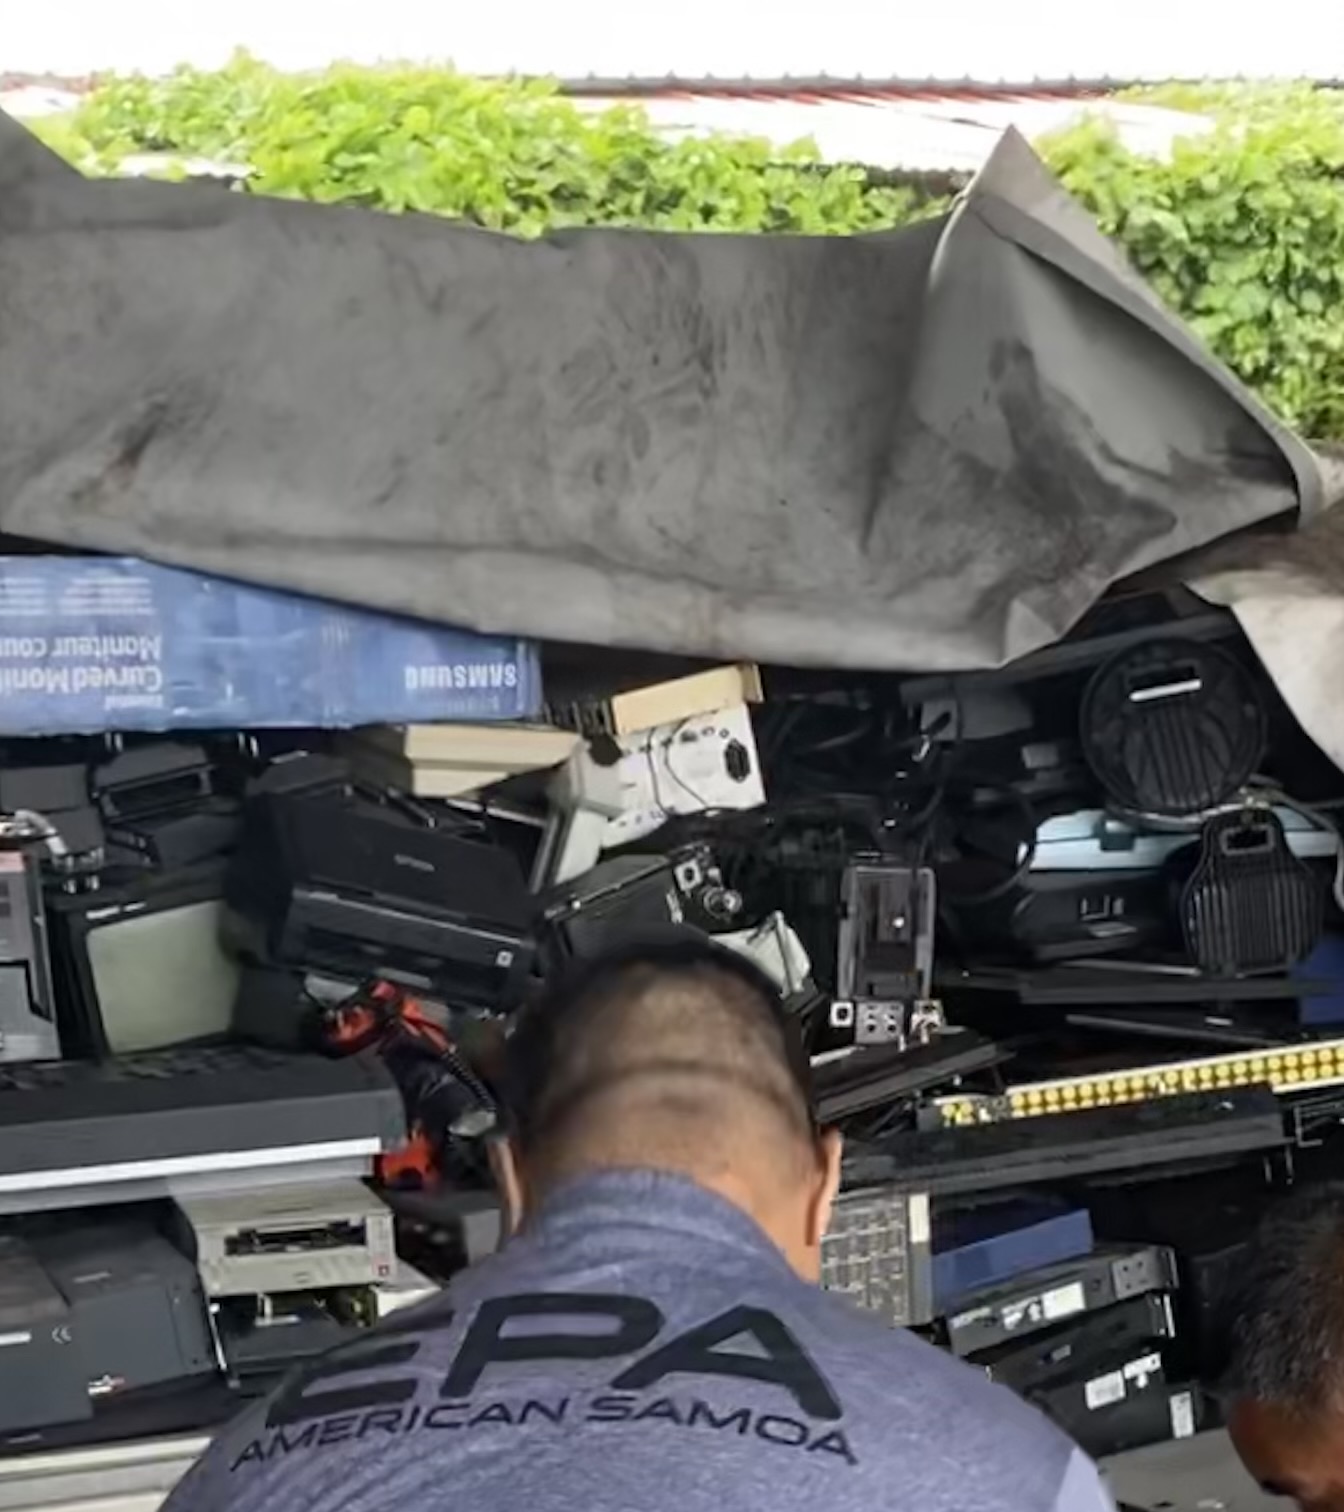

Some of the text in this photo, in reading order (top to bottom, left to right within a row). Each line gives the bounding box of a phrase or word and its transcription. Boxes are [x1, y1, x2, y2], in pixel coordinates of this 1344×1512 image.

[51, 634, 162, 661] Moniteur
[71, 665, 163, 693] Curved
[404, 663, 517, 689] SAMSUNG
[265, 1292, 843, 1428] EPA
[230, 1395, 860, 1472] AMERICAN SAMOA
